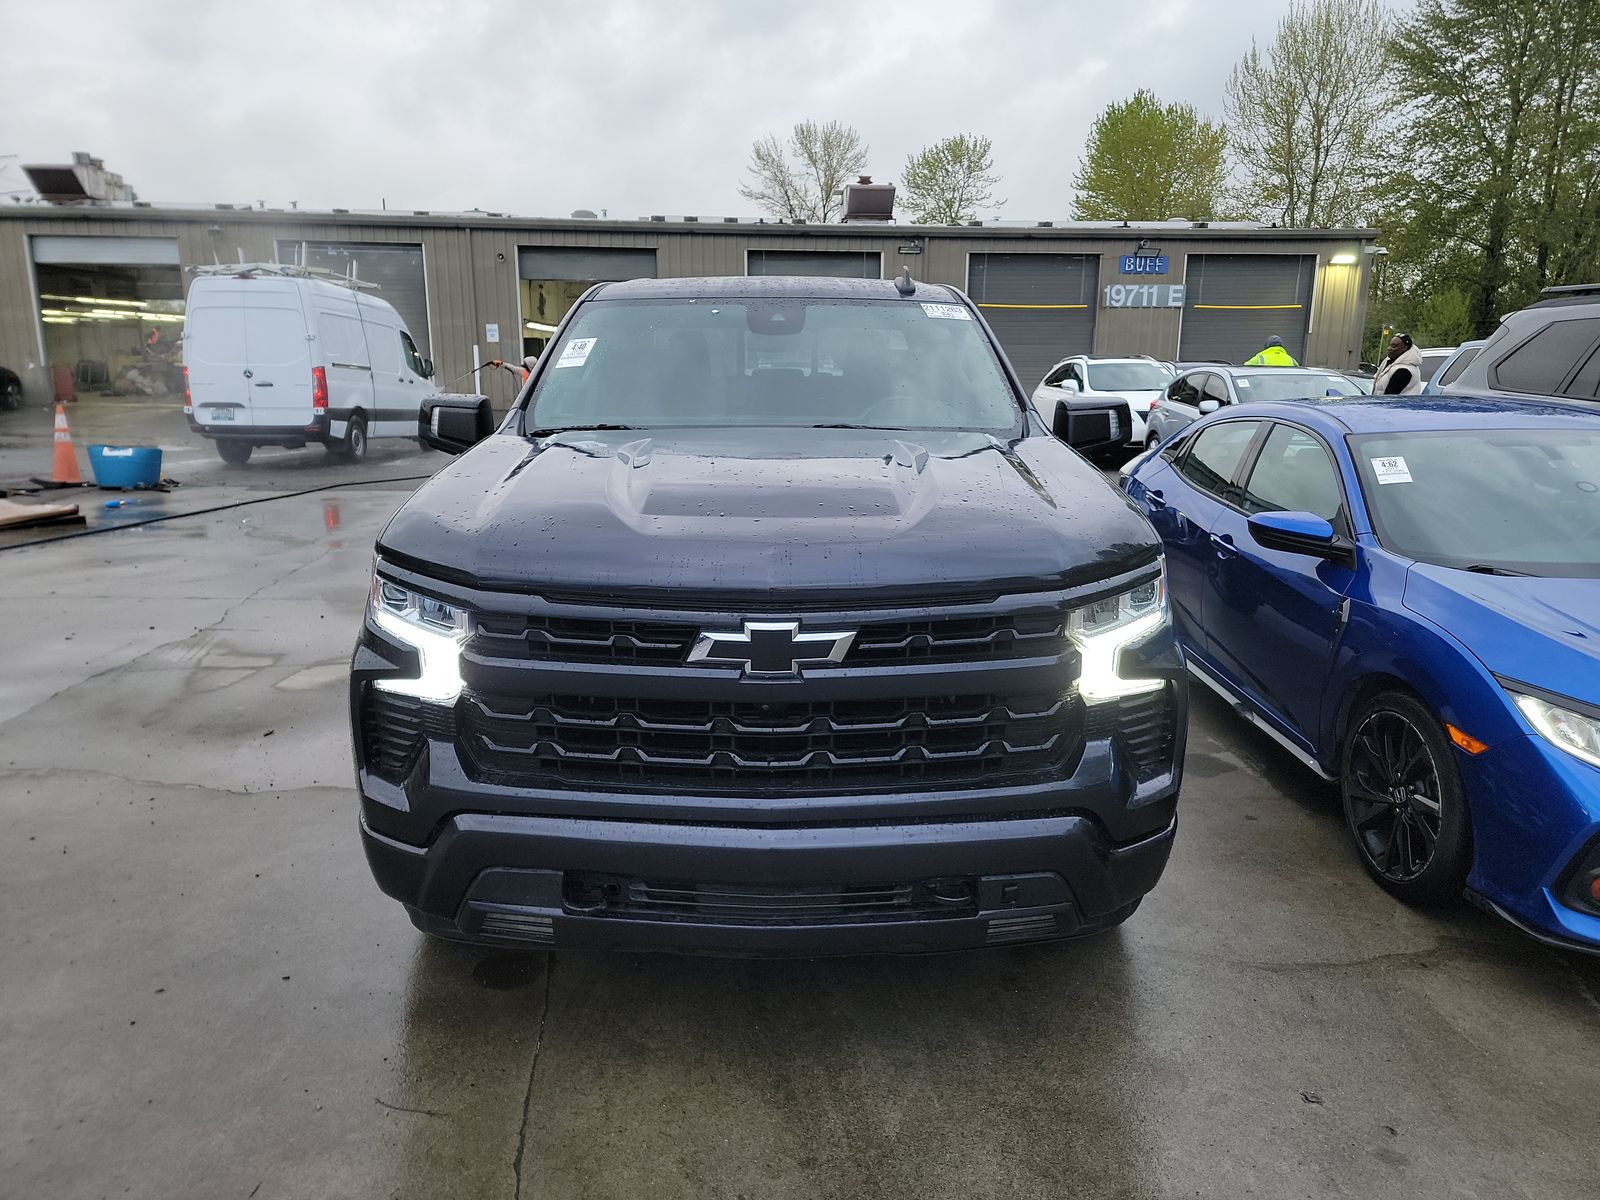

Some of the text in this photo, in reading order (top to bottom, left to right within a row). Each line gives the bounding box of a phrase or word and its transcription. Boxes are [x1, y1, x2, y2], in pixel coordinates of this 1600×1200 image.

[1124, 257, 1164, 272] BUFF
[1104, 284, 1184, 307] 19711 E
